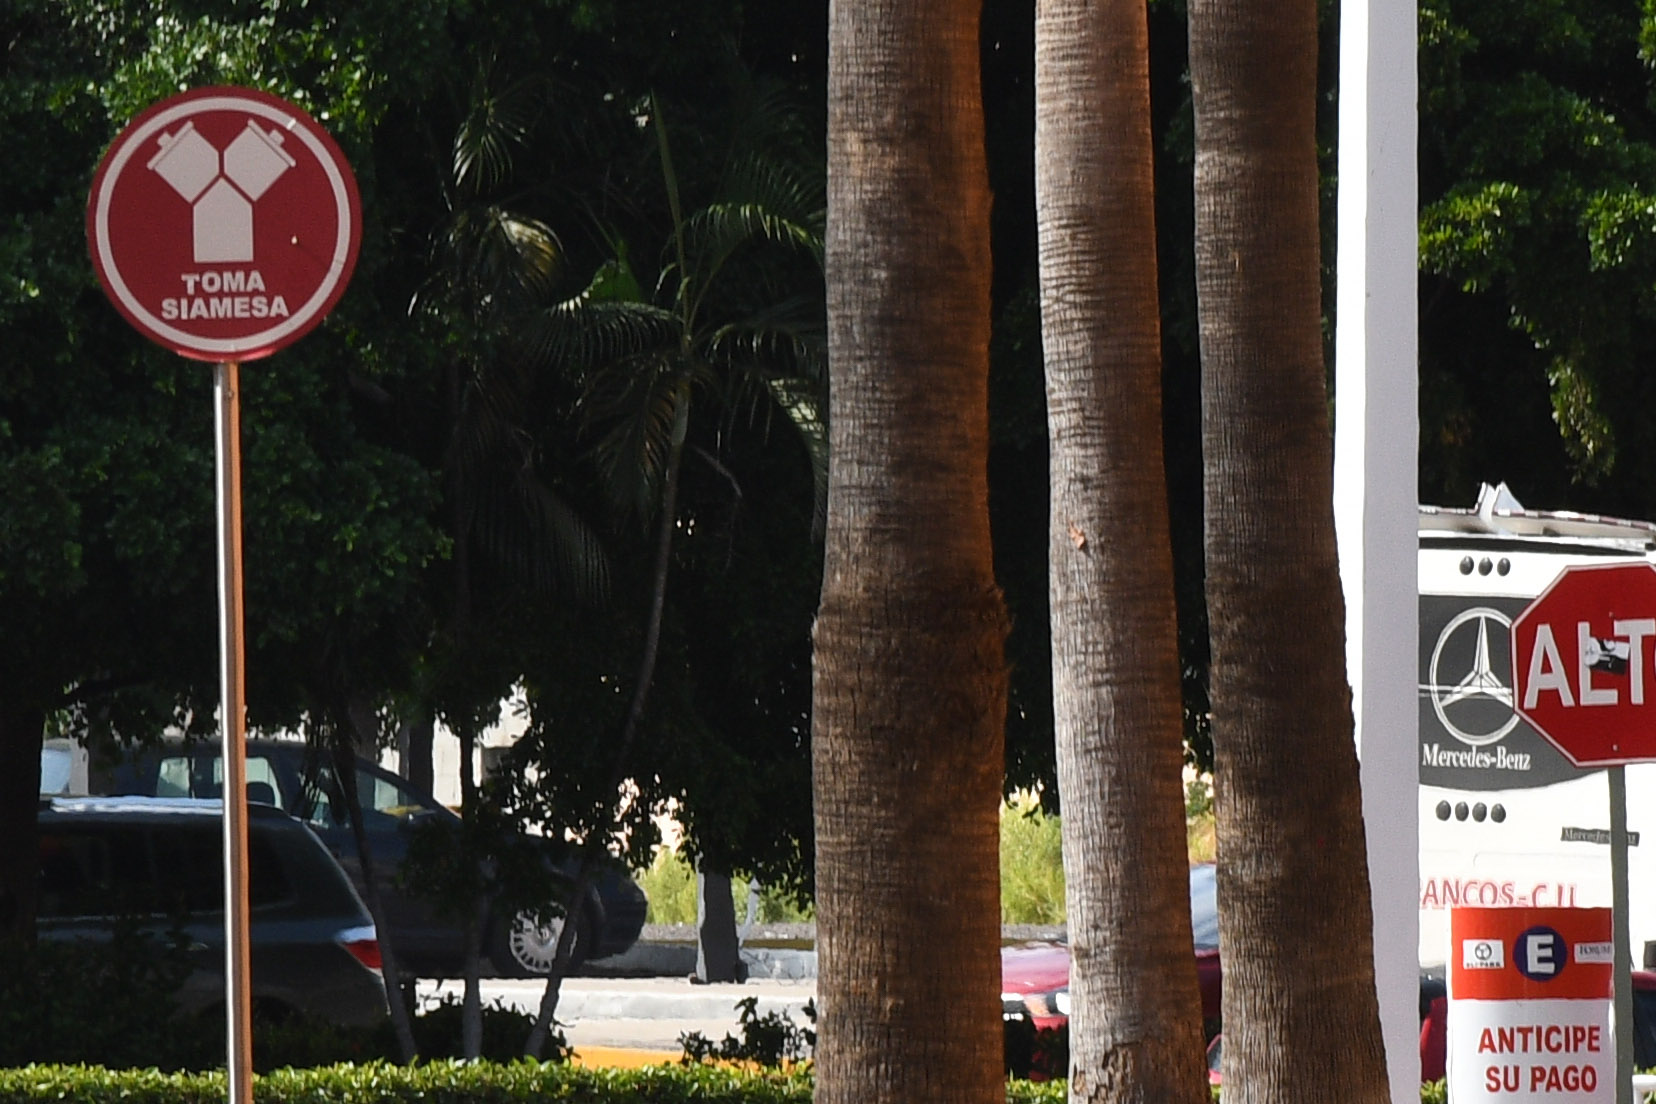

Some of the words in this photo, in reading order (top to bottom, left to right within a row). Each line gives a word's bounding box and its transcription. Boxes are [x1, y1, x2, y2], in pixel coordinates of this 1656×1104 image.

[181, 270, 265, 295] TOMA
[161, 295, 289, 320] SIAMESA
[1422, 743, 1531, 770] Mercedes-Benz
[1526, 933, 1556, 975] E
[1478, 1025, 1600, 1053] ANTICIPE
[1485, 1065, 1520, 1092] SU
[1530, 1064, 1597, 1092] PAGO
